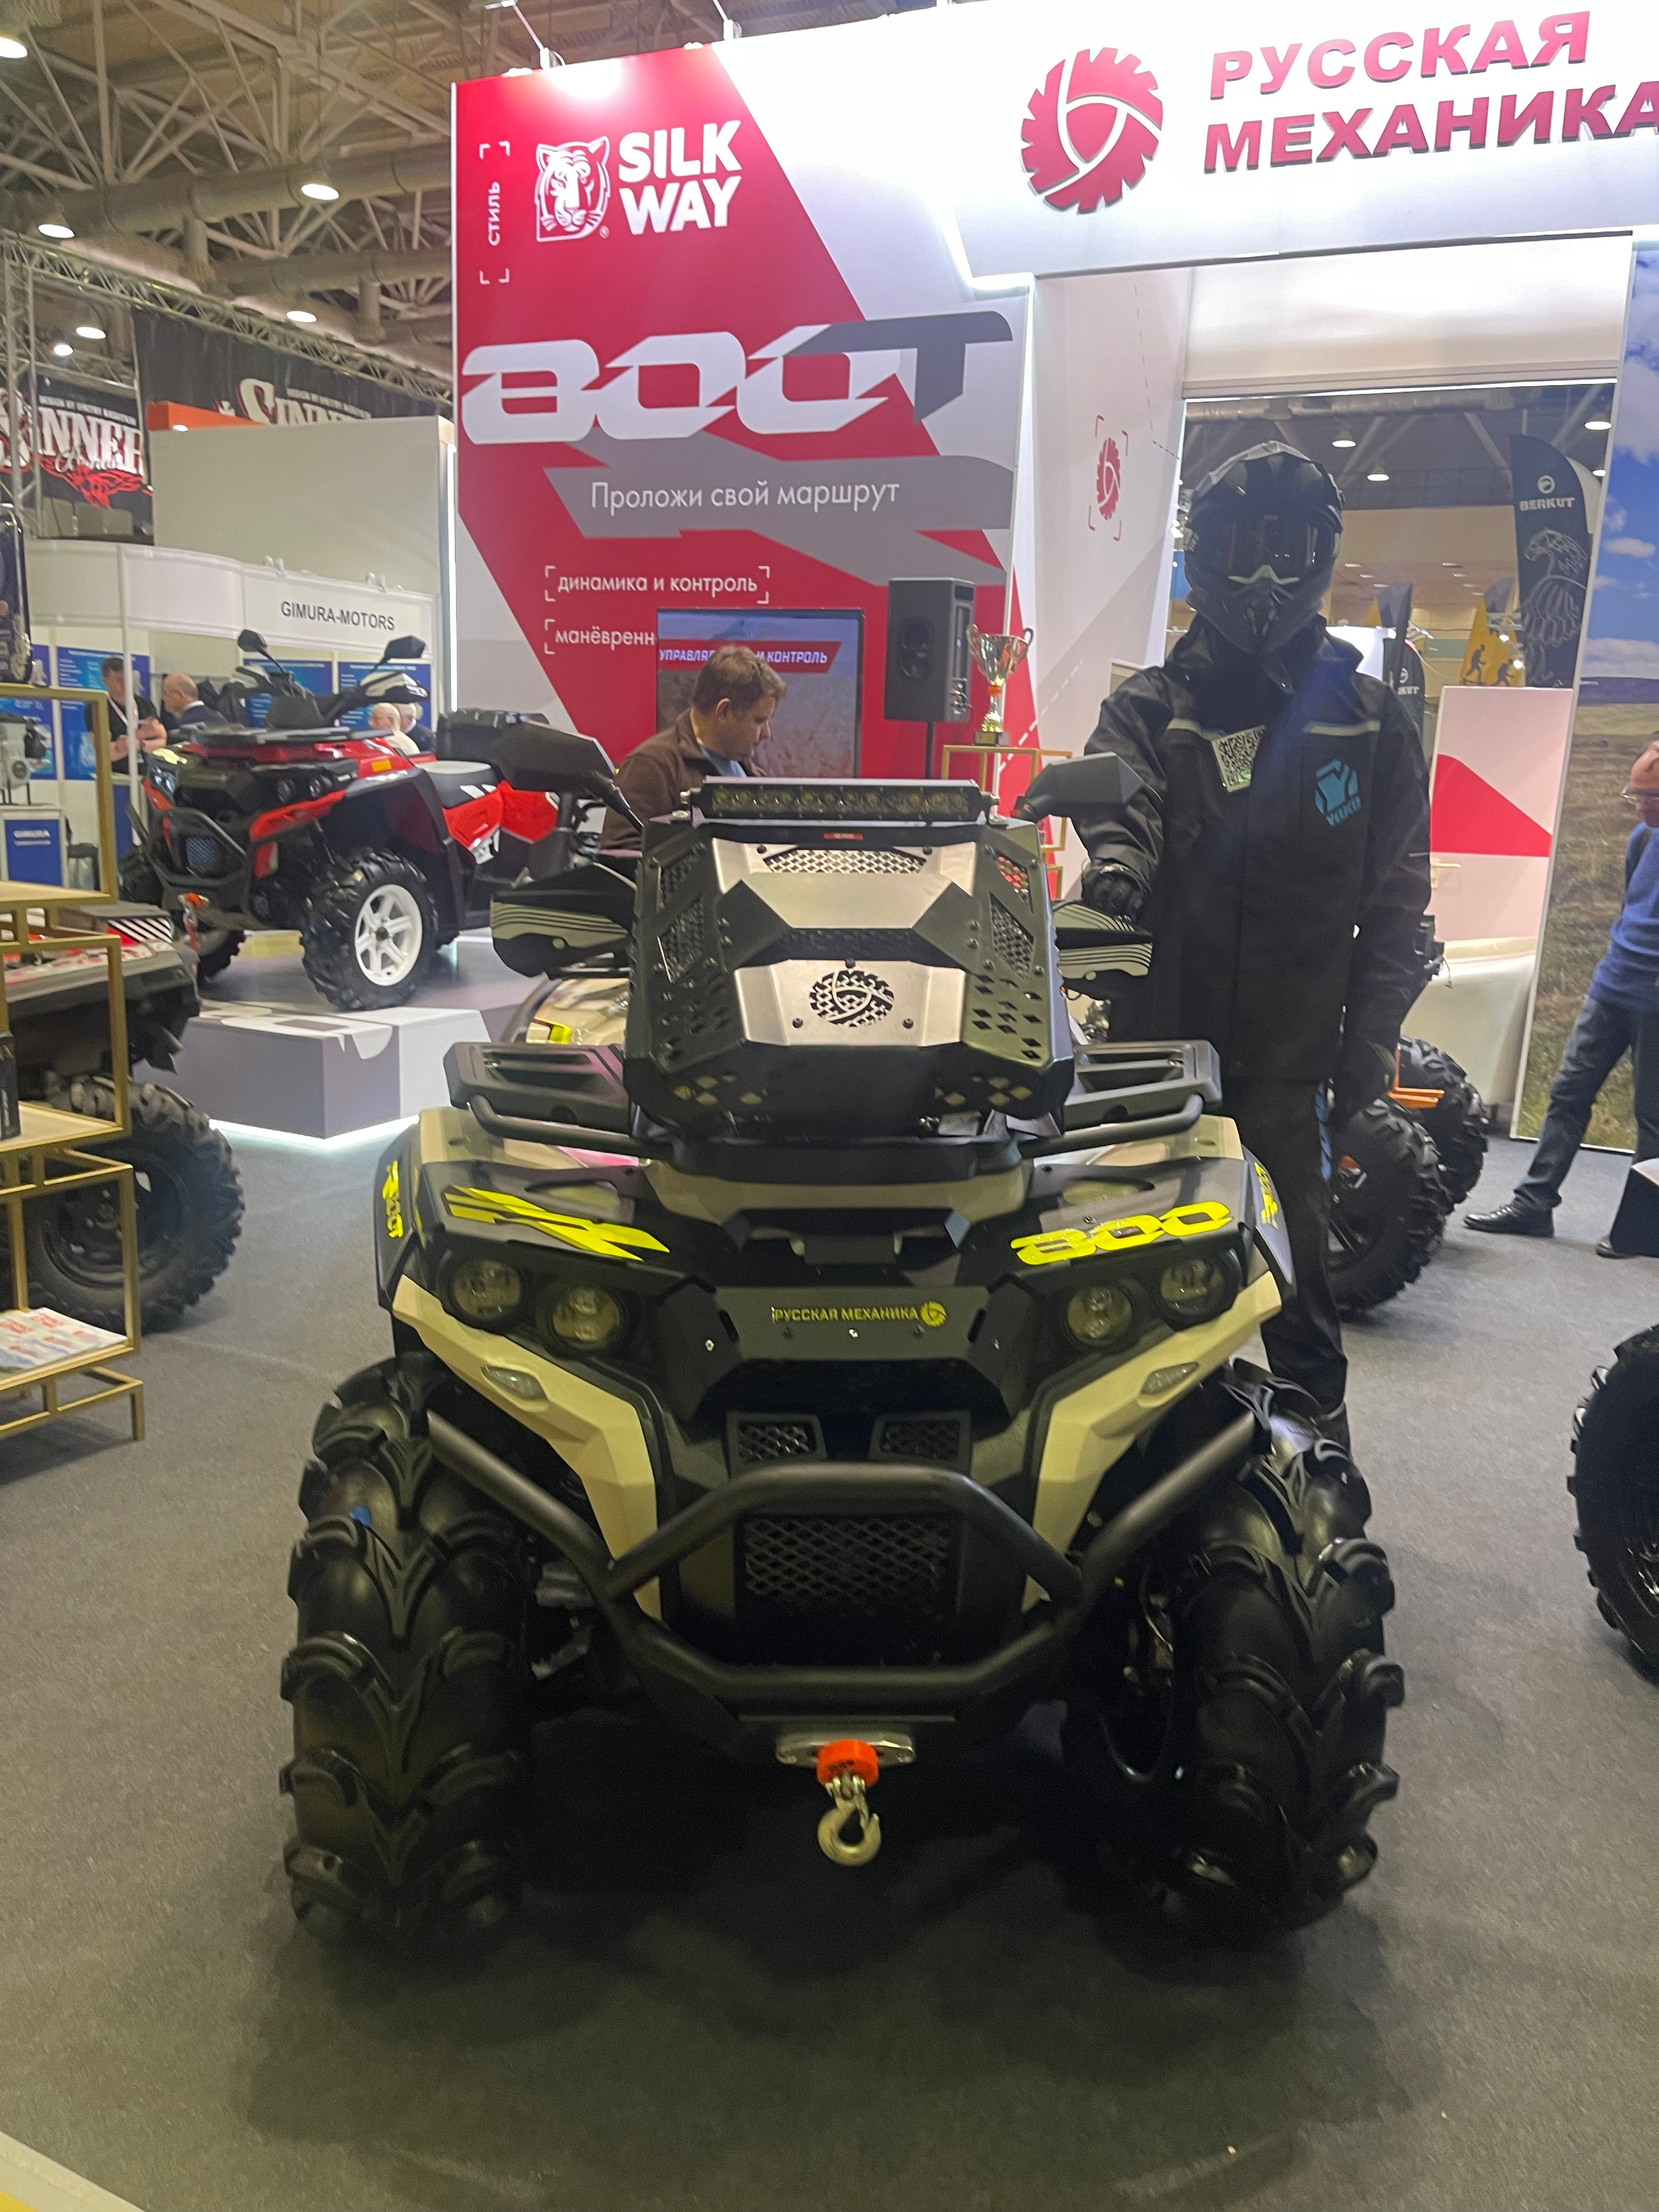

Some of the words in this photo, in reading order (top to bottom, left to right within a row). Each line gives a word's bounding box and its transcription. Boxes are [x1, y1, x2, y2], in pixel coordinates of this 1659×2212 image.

[1210, 11, 1590, 100] РУССКАЯ
[1204, 81, 1659, 174] МЕХАНИКА
[618, 119, 743, 183] SILK
[488, 181, 500, 246] СТИЛЬ
[618, 175, 742, 235] WAY
[592, 482, 702, 516] Проложи
[710, 480, 769, 507] свой
[777, 483, 900, 513] маршрут
[1519, 497, 1575, 511] BERKUT
[557, 576, 647, 593] динамика
[653, 577, 664, 591] и
[670, 577, 758, 598] контроль
[281, 601, 396, 631] GIMURA-MOTORS
[555, 626, 655, 651] манёвренн
[659, 649, 716, 662] УПРАВЛЯ
[767, 651, 828, 664] КОНТРОЛЬ
[772, 1307, 838, 1322] РУССКАЯ
[841, 1307, 920, 1321] МЕХАНИКА
